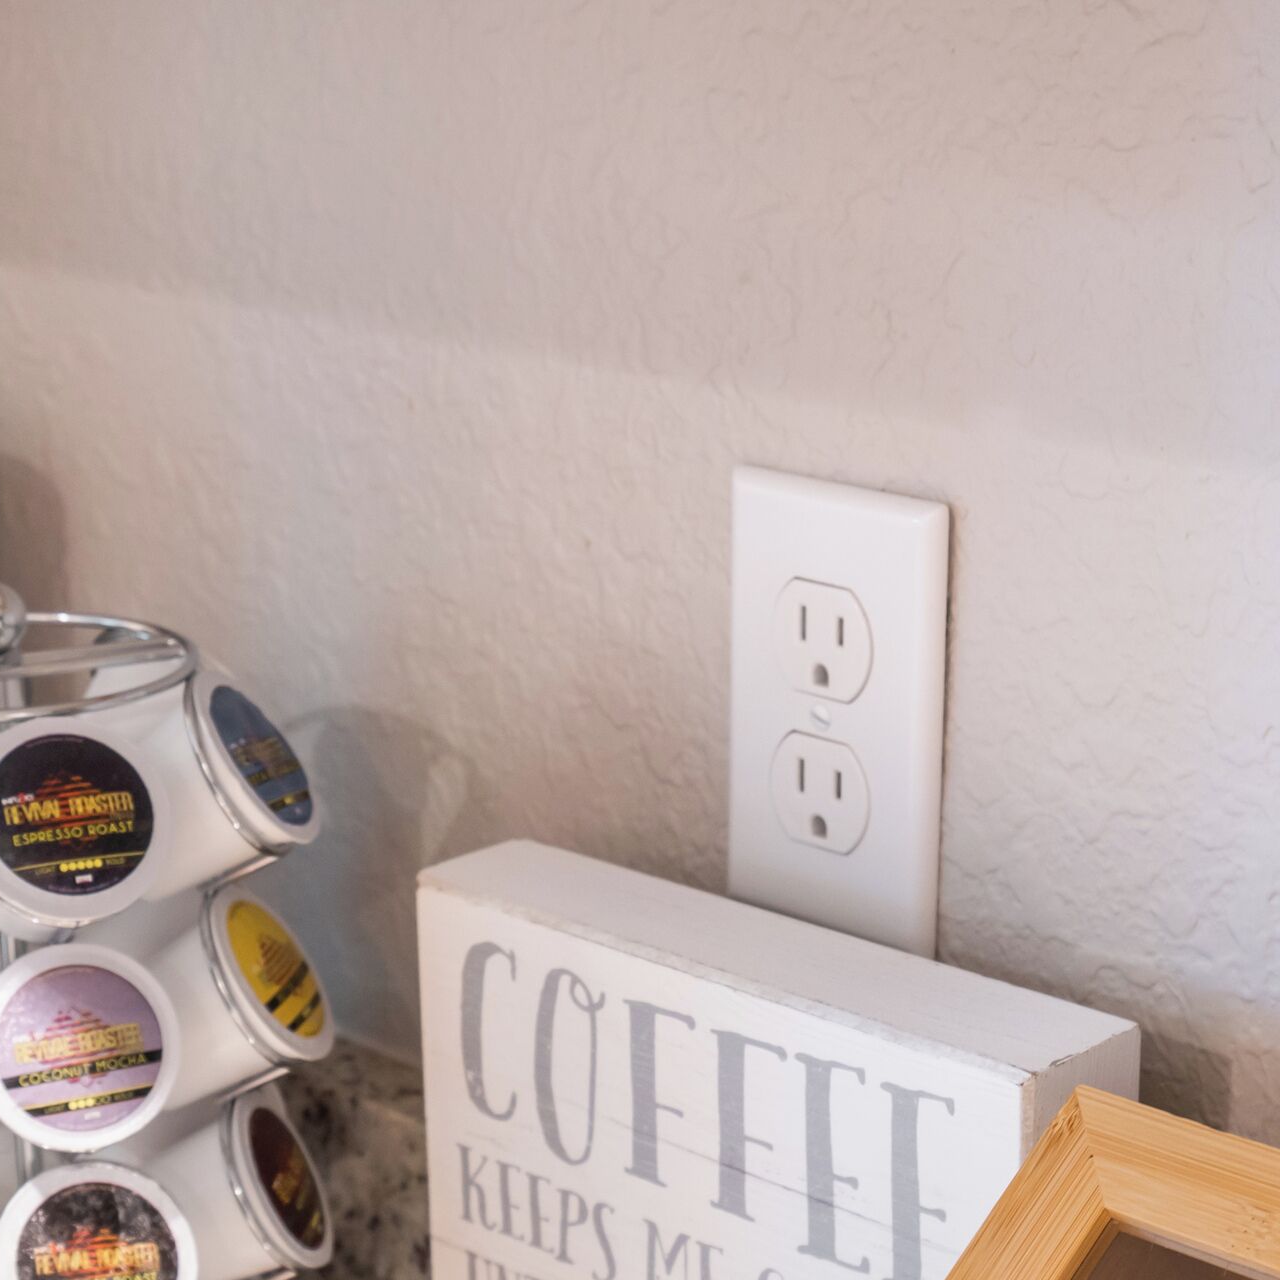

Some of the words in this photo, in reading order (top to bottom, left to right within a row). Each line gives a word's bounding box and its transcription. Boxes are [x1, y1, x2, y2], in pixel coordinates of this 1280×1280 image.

[12, 825, 83, 847] ESPRESSO
[87, 820, 134, 837] ROAST
[18, 1064, 91, 1087] COCONUT
[96, 1054, 146, 1072] MOCHA
